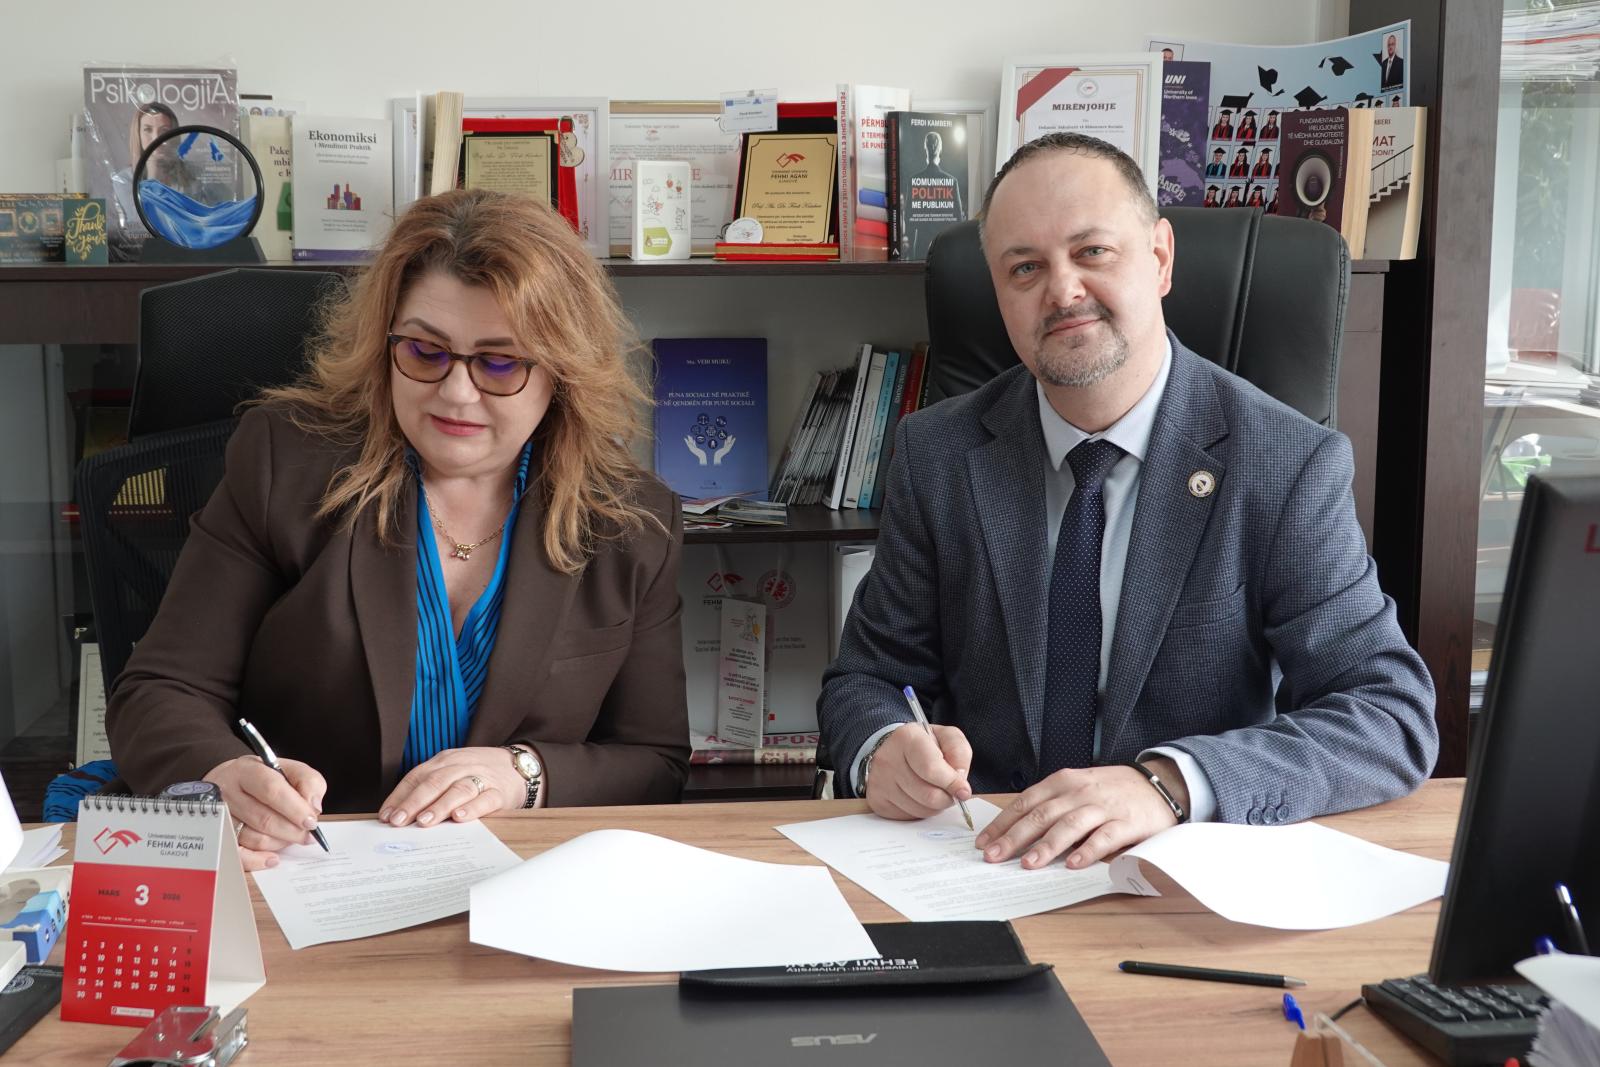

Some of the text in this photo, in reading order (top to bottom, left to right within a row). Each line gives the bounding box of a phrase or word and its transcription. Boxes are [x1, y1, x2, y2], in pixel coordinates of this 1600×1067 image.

[1164, 74, 1187, 84] UNI
[910, 118, 927, 127] FERDI
[308, 129, 377, 144] Ekonomiksi
[911, 177, 954, 186] KOMUNIKIMI
[911, 187, 954, 200] POLITIK
[911, 201, 954, 209] ME PUBLIKUN
[146, 839, 204, 851] FEHMI AGANI
[134, 883, 150, 907] 3
[82, 940, 88, 948] 2
[100, 941, 105, 949] 3
[154, 945, 159, 953] 6
[172, 946, 177, 954] 7
[81, 952, 87, 960] 9
[98, 954, 106, 962] 10
[117, 955, 123, 963] 11
[134, 956, 141, 965] 12
[169, 959, 177, 967] 14
[856, 958, 918, 967] FEHMI
[97, 966, 104, 974] 17
[132, 969, 140, 977] 19
[149, 970, 159, 978] 20
[168, 972, 176, 980] 21
[77, 978, 87, 986] 23
[95, 979, 104, 987] 24
[148, 983, 158, 991] 27
[95, 991, 103, 1000] 31
[790, 1032, 877, 1048] ASUS
